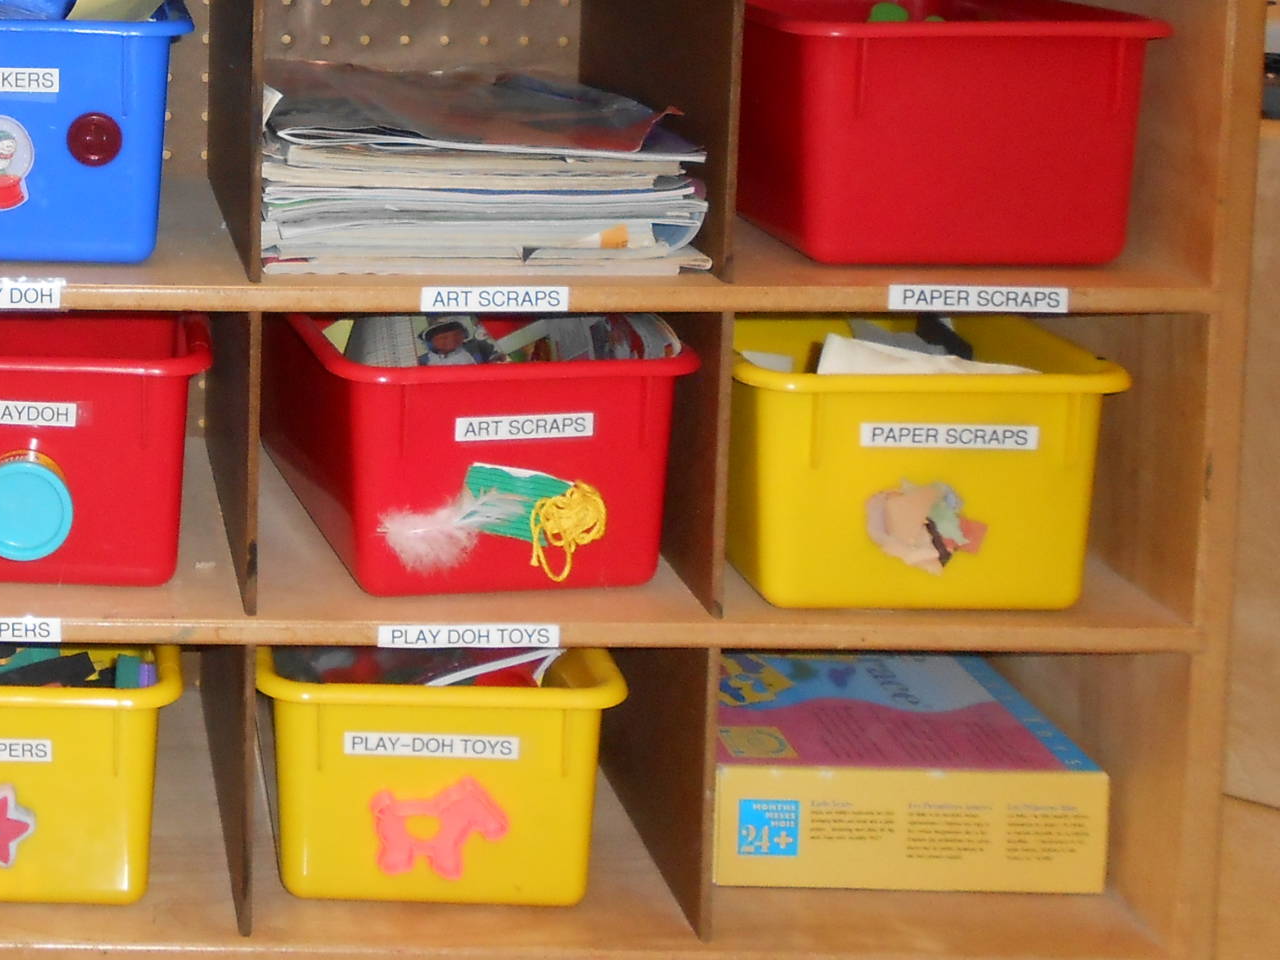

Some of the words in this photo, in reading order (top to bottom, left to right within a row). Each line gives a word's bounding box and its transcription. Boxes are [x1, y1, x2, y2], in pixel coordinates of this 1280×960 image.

[9, 288, 53, 304] DOH
[432, 292, 473, 306] ART
[478, 291, 560, 307] SCRAPS
[903, 289, 970, 306] PAPER
[977, 291, 1060, 308] SCRAPS
[464, 421, 503, 437] ART
[508, 417, 586, 435] SCRAPS
[871, 428, 938, 443] PAPER
[945, 428, 1029, 446] SCRAPS
[391, 630, 440, 645] PLAY
[447, 629, 490, 644] DOH
[497, 628, 550, 643] TOYS
[352, 736, 454, 753] PLAY-DOH
[461, 739, 513, 755] TOYS
